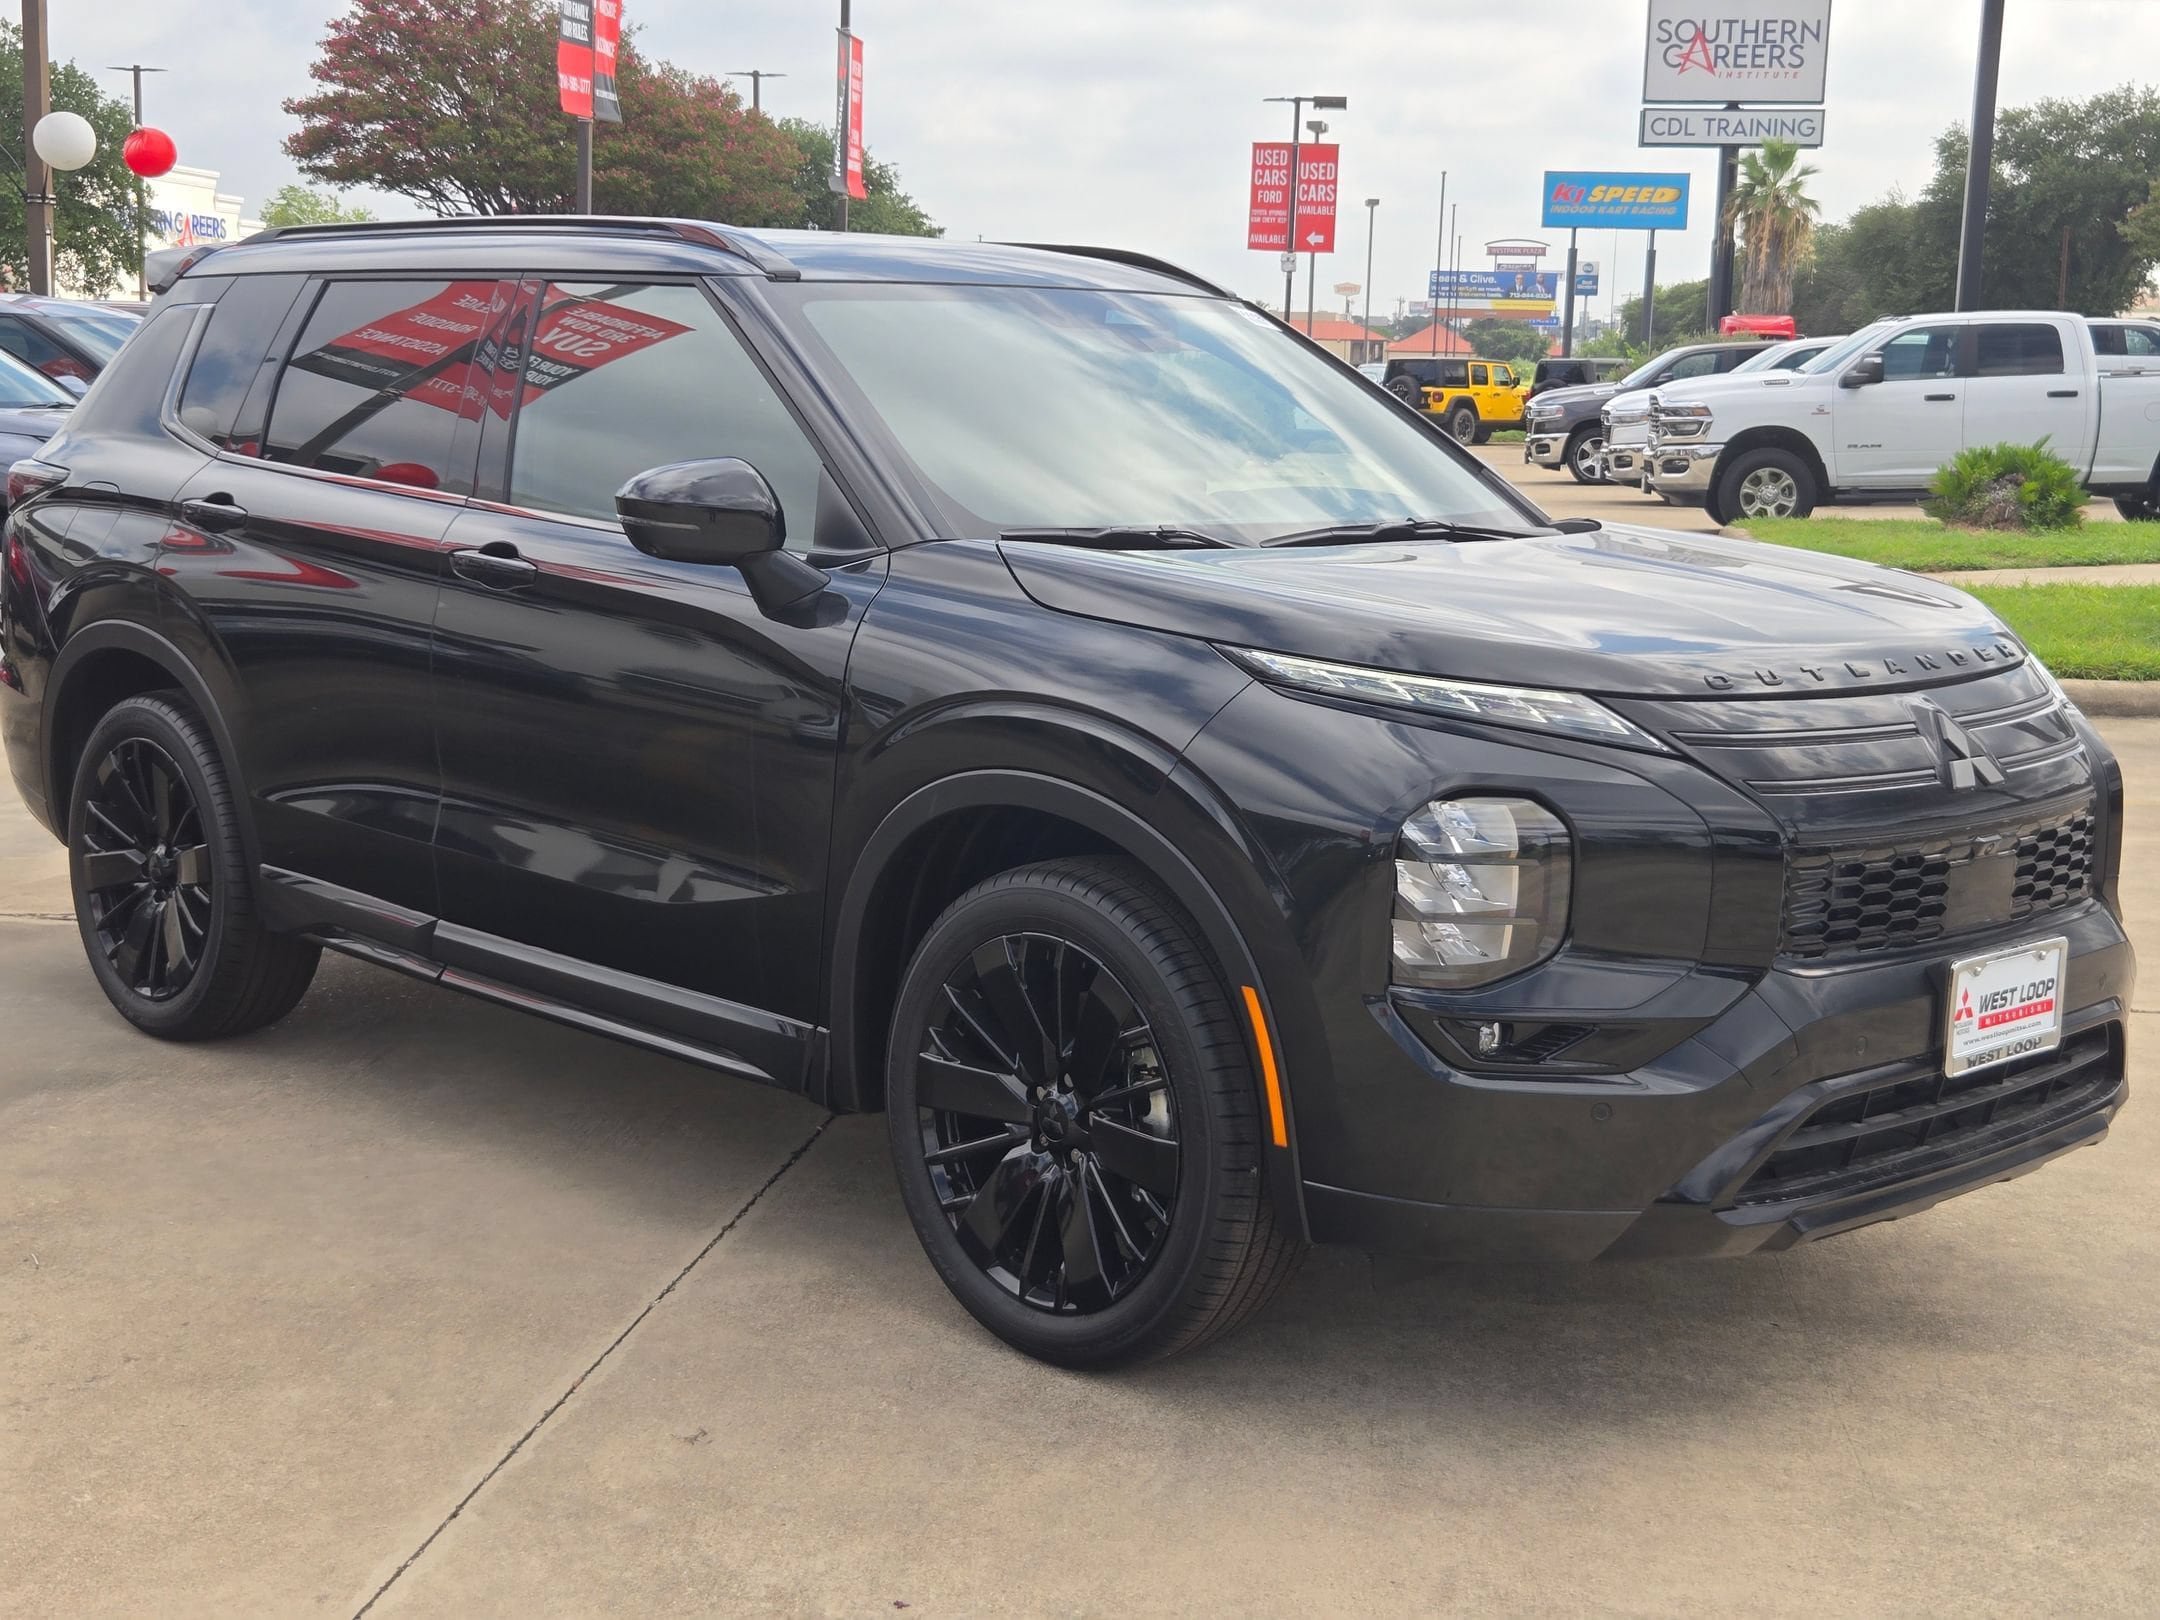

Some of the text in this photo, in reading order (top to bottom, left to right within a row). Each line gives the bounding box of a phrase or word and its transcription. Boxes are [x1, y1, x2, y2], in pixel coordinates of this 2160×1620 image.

[1655, 18, 1822, 44] SOUTHERN
[1662, 36, 1805, 75] CAREERS
[1718, 71, 1800, 80] INSTITUTE
[1650, 117, 1816, 138] CDL TRAINING
[1255, 149, 1288, 166] USED
[1254, 169, 1288, 186] CARS
[1300, 162, 1336, 180] USED
[1299, 184, 1336, 202] CARS
[1552, 182, 1682, 204] K1 SPEED
[1297, 205, 1335, 216] AVAILABLE
[1551, 205, 1677, 215] INDOOR KART RACING
[174, 210, 227, 247] CAREERS
[1249, 233, 1286, 245] AVAILABLE
[1431, 273, 1497, 284] Sean & Clive.
[1704, 643, 2016, 691] OUTLANDER
[1978, 978, 2055, 1014] WEST LOOP
[1985, 1003, 2048, 1025] MITSUBISHI
[1967, 1037, 2042, 1068] WEST LOOP
